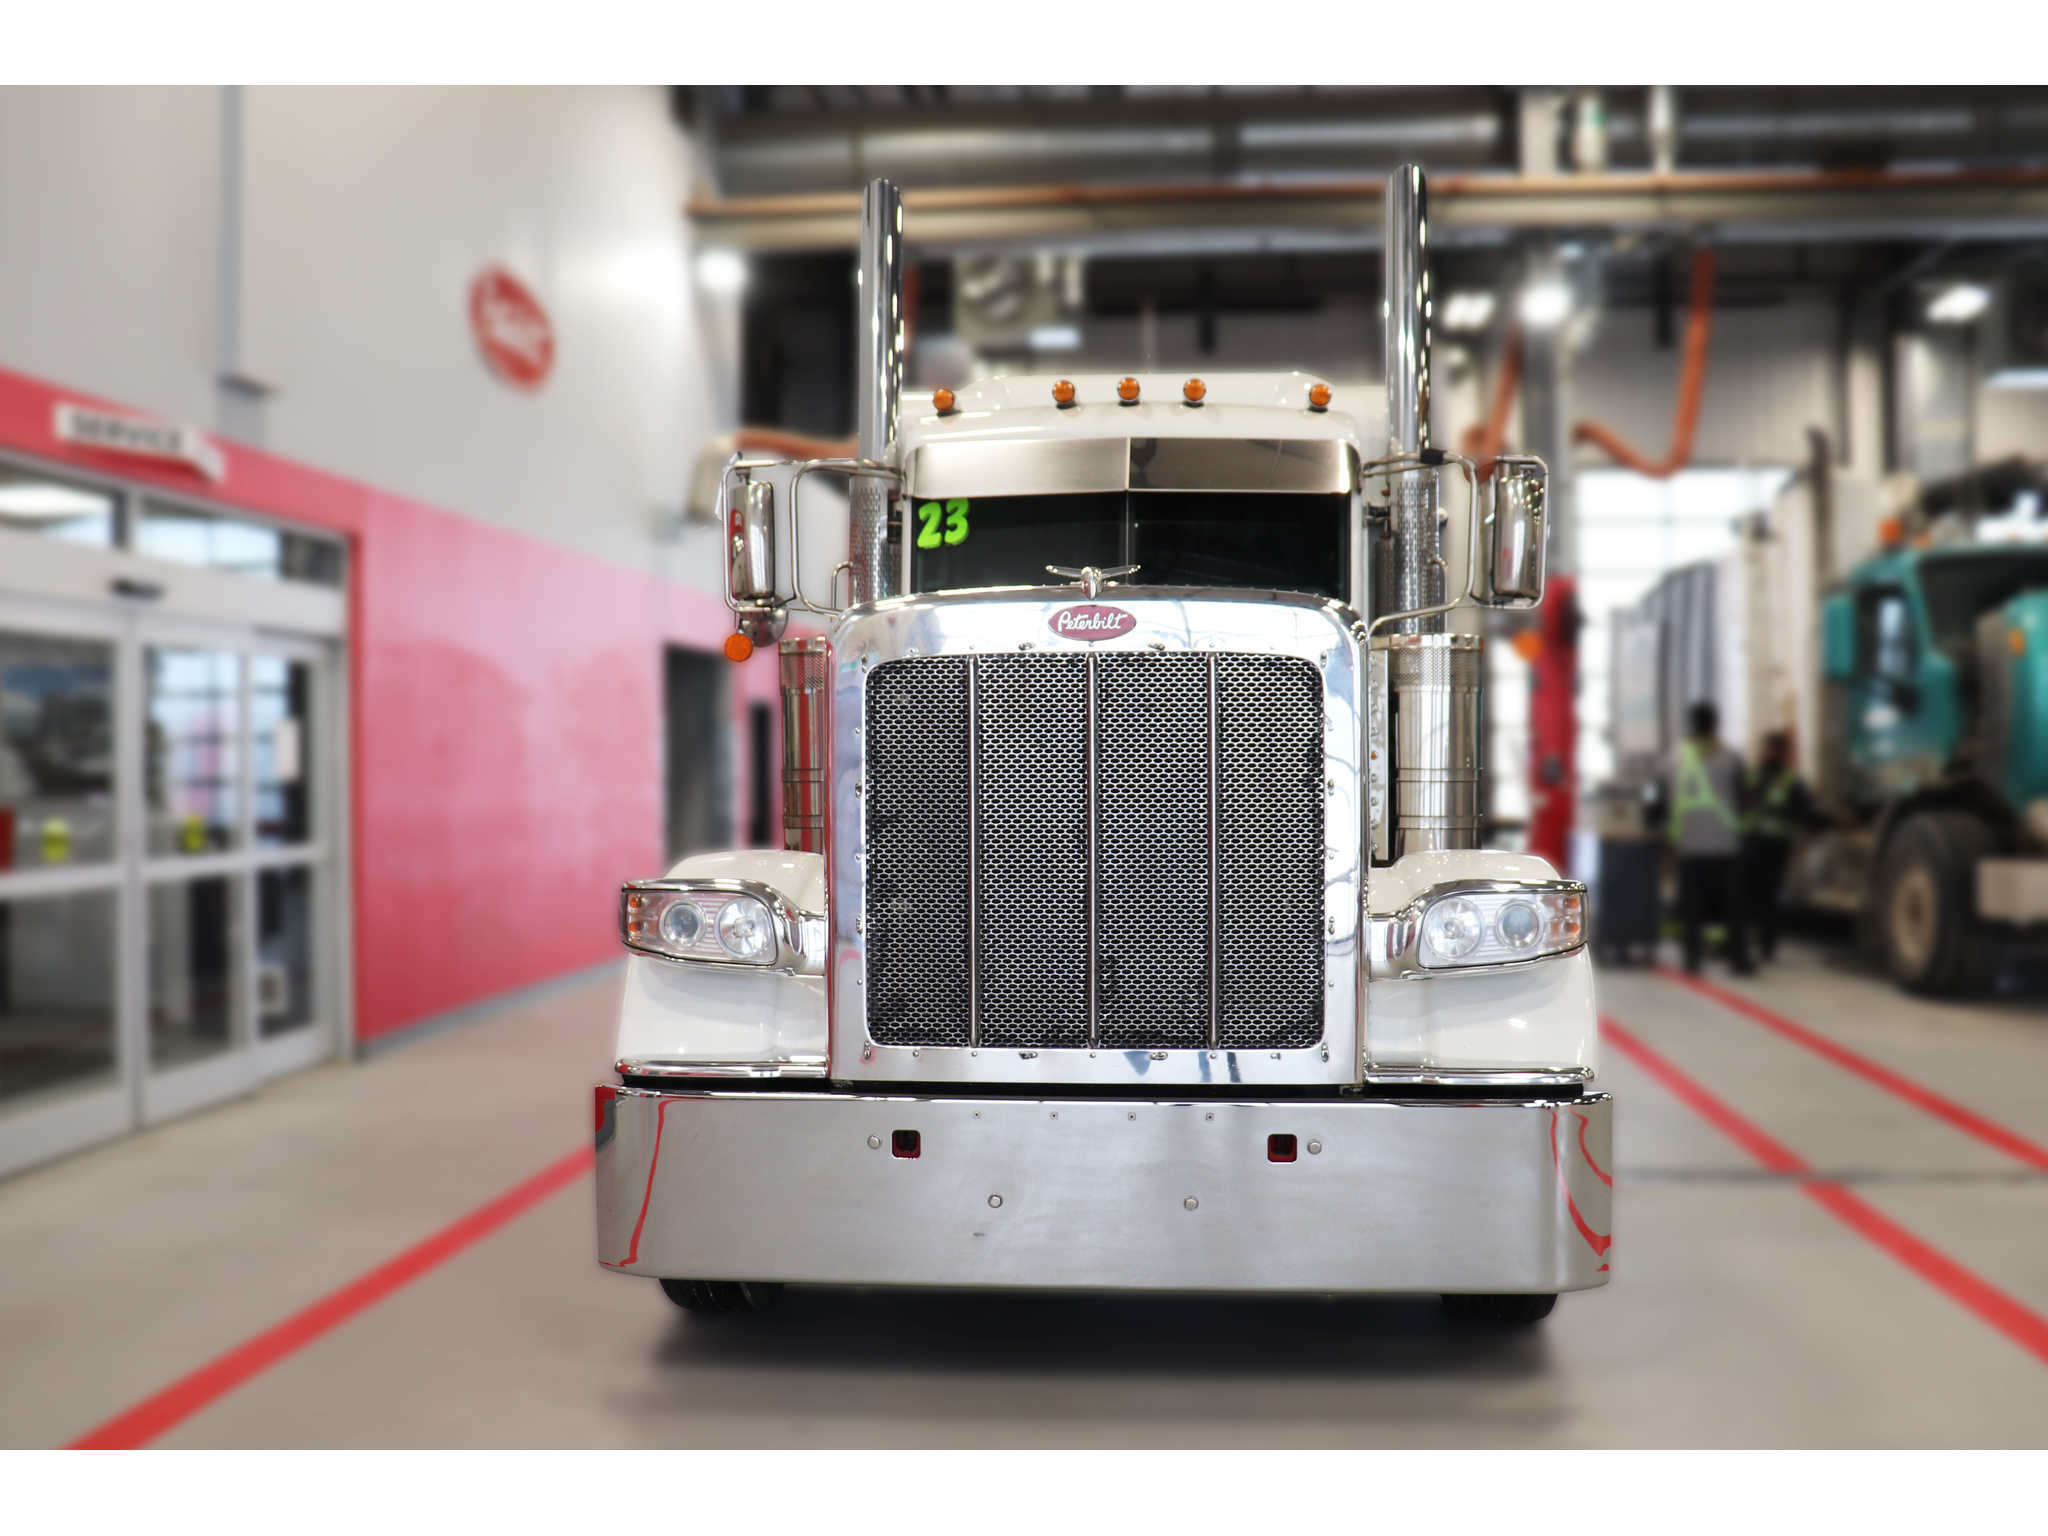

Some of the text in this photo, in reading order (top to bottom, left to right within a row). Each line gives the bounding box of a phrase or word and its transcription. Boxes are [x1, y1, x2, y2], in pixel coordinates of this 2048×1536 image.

[70, 411, 183, 454] SERVICE
[917, 498, 970, 549] 23
[1057, 610, 1129, 632] Peterbilt
